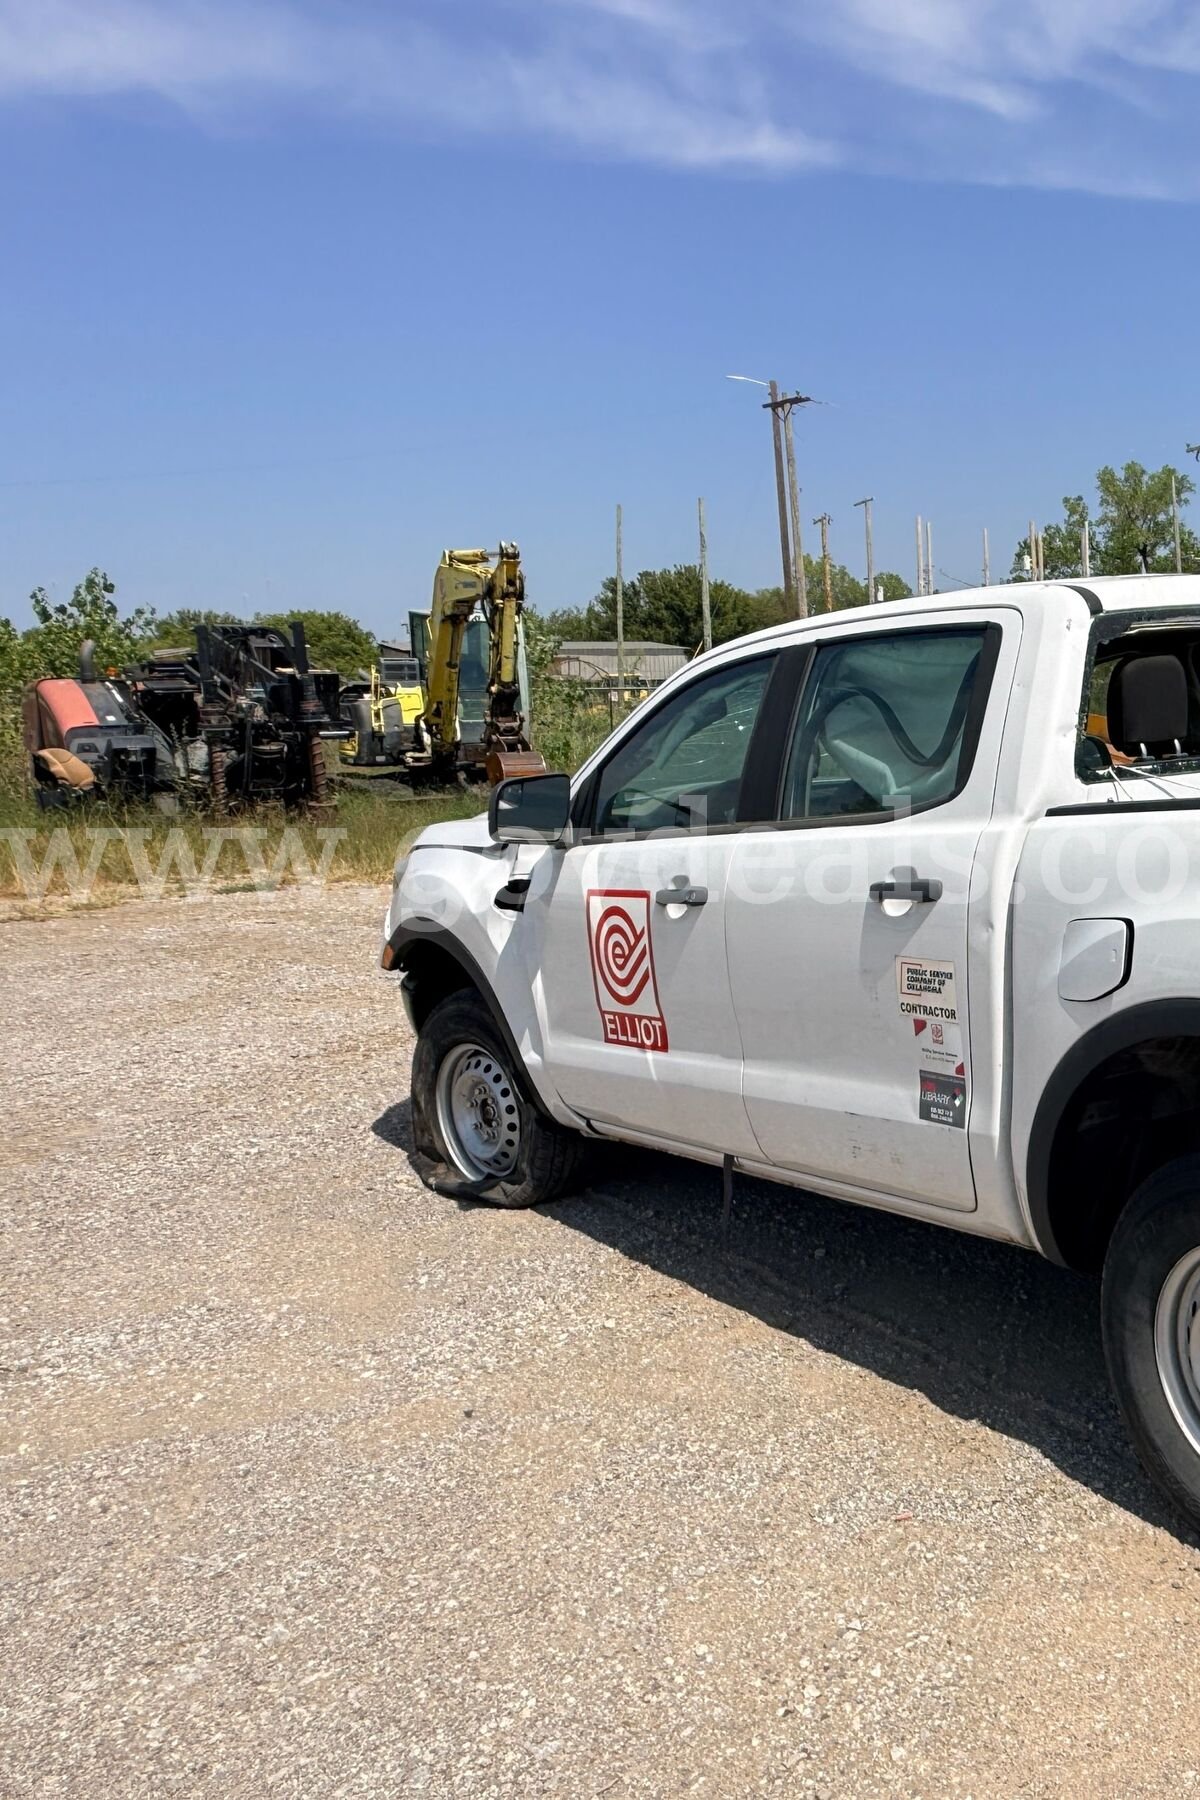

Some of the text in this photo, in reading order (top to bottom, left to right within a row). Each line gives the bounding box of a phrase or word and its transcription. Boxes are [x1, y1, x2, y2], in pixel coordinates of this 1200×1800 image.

[929, 970, 953, 980] SERVICE
[900, 1002, 957, 1020] CONTRACTOR
[604, 1013, 663, 1048] ELLIOT
